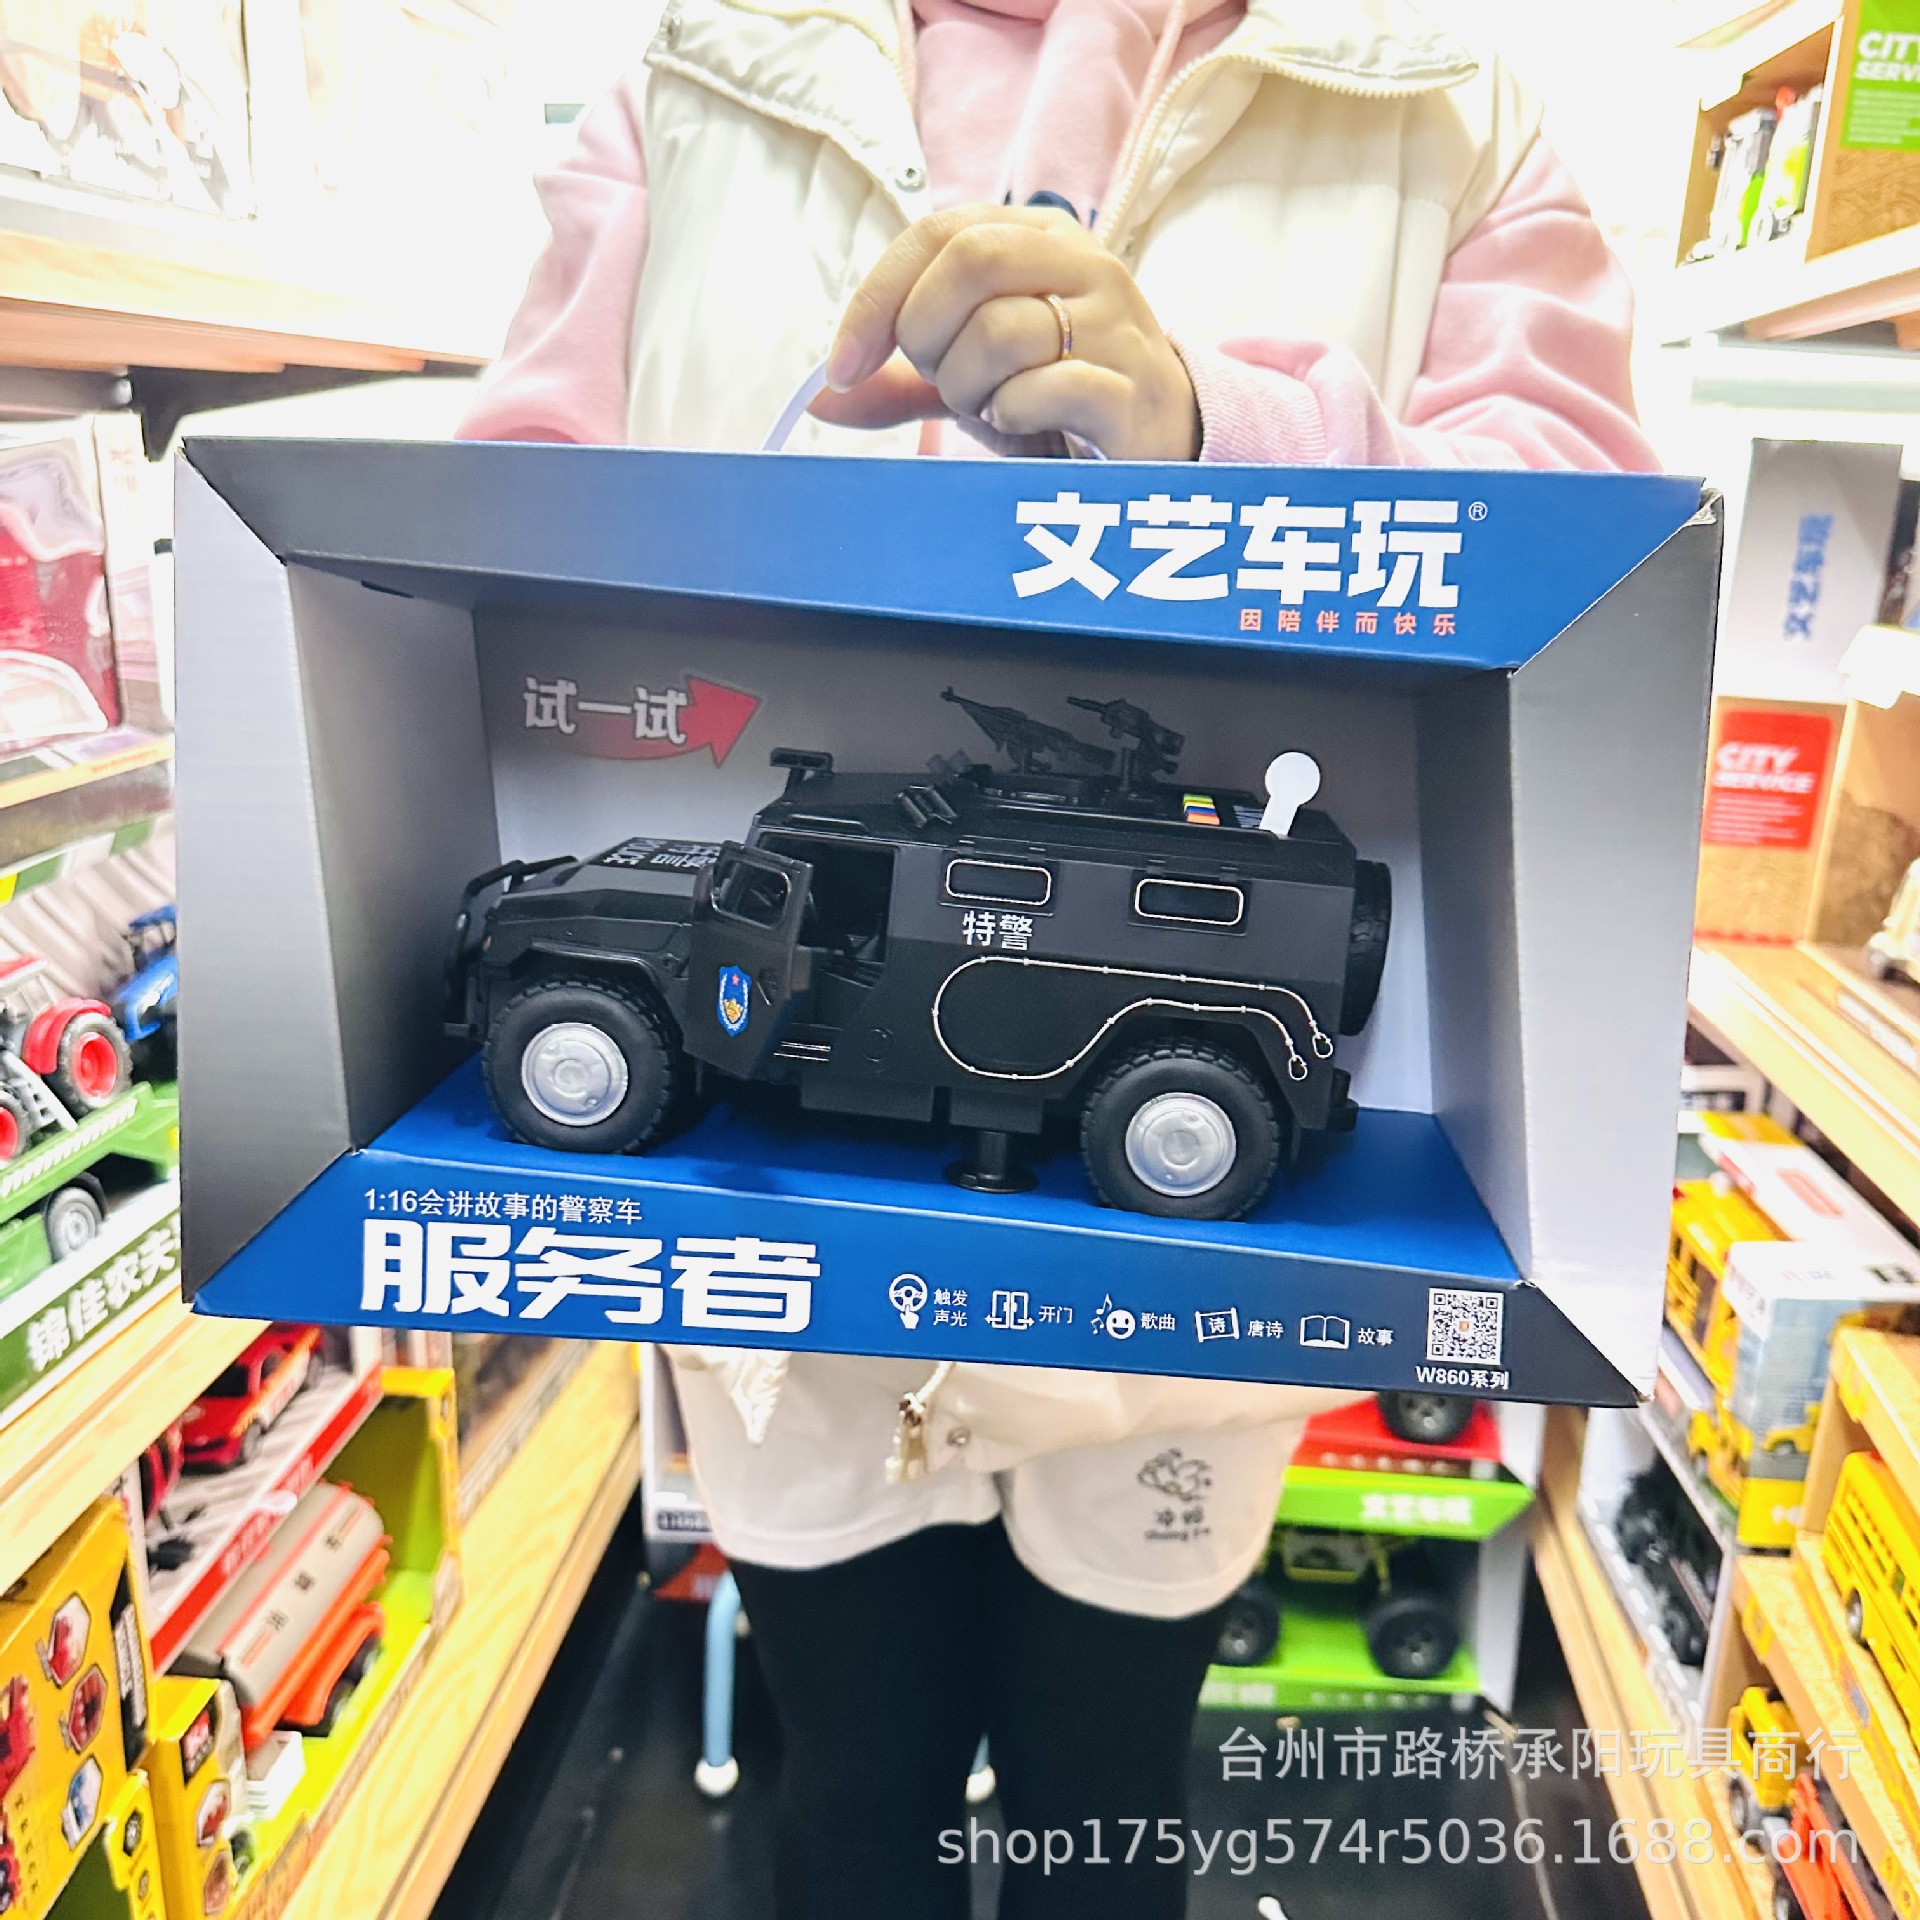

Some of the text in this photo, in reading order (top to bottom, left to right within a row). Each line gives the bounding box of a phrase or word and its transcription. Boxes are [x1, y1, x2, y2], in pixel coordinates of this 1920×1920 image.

[1012, 491, 1463, 608] 文艺车玩
[1239, 608, 1457, 636] 因陪伴而快乐
[523, 676, 688, 745] 试一试
[1717, 742, 1800, 772] CITY
[962, 910, 1033, 951] 特警
[364, 1187, 644, 1226] 1:16会讲故事的警察车
[360, 1218, 821, 1333] 服务者
[933, 1288, 968, 1307] 触发
[933, 1309, 968, 1328] 声光
[1038, 1305, 1073, 1325] 开门
[1140, 1312, 1176, 1332] 歌曲
[1247, 1319, 1284, 1340] 唐诗
[1357, 1327, 1394, 1347] 故事
[1414, 1365, 1510, 1390] W860系列
